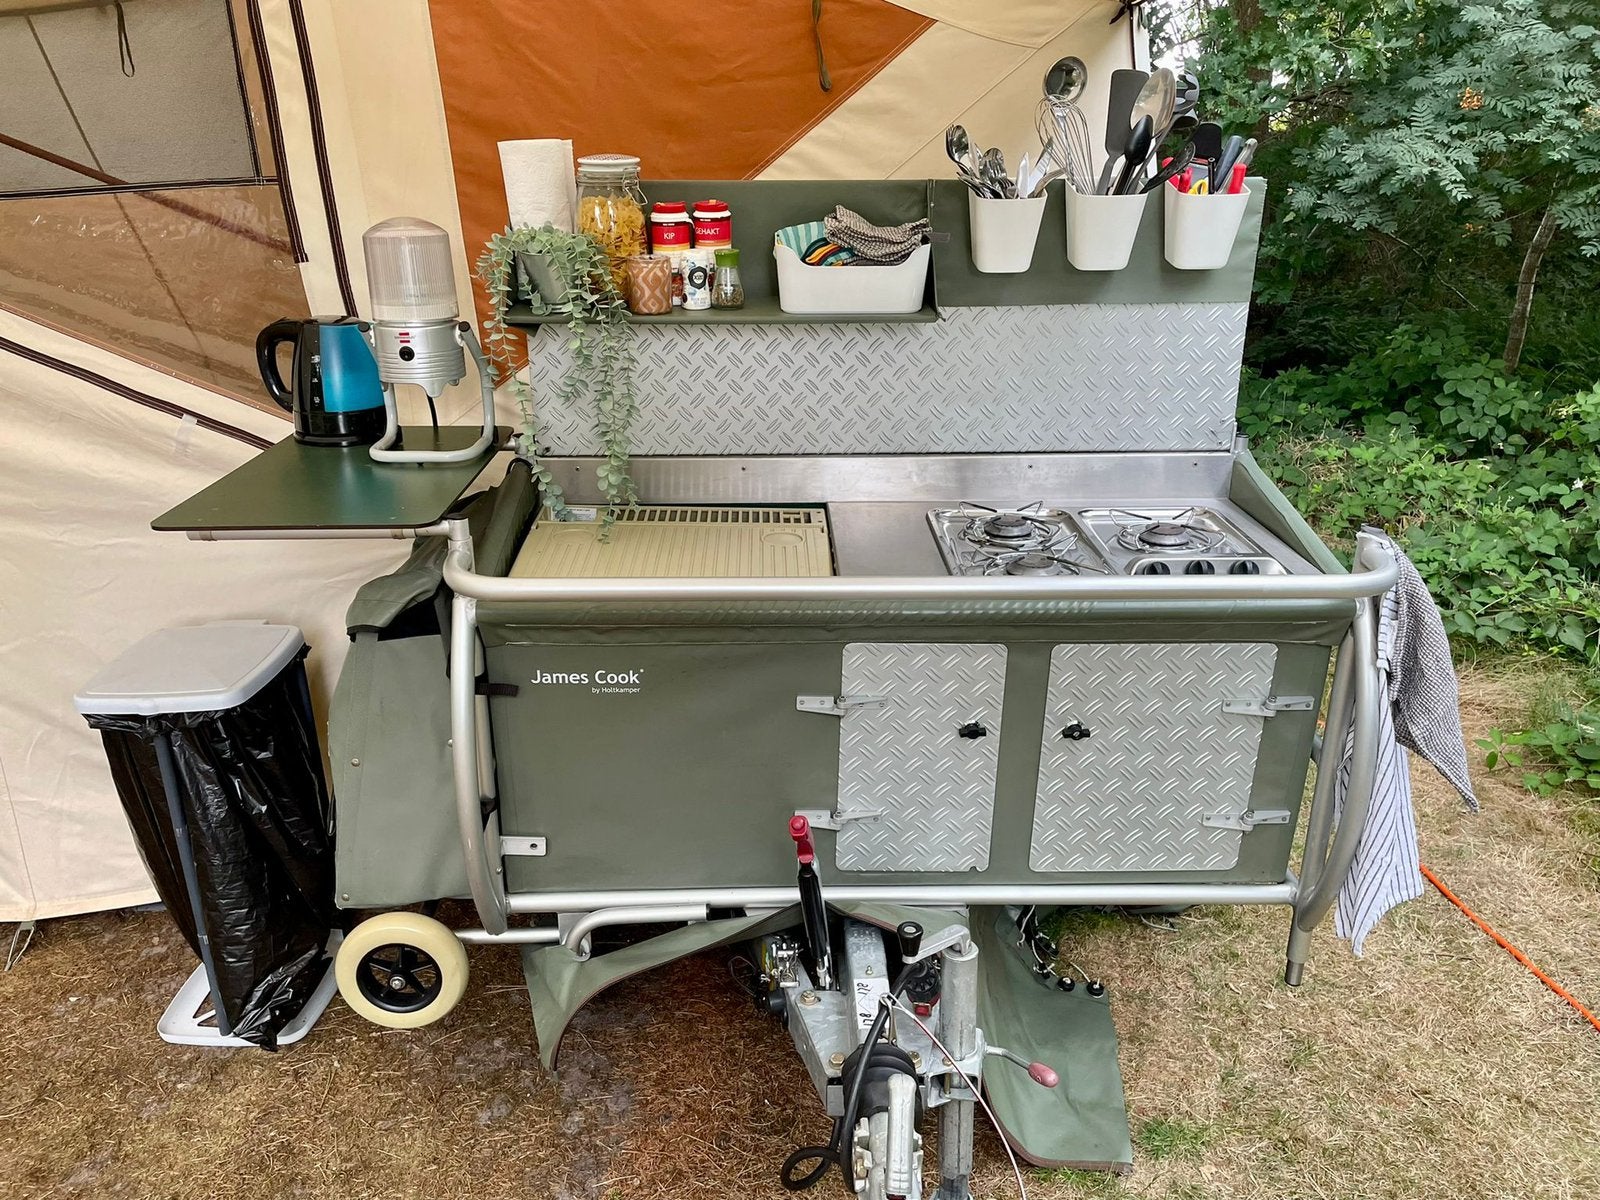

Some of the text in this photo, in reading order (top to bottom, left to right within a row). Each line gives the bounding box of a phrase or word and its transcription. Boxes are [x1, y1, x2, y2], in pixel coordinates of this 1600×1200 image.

[695, 227, 720, 235] GEHAKT
[531, 669, 589, 684] James
[601, 686, 641, 694] Holtkamper
